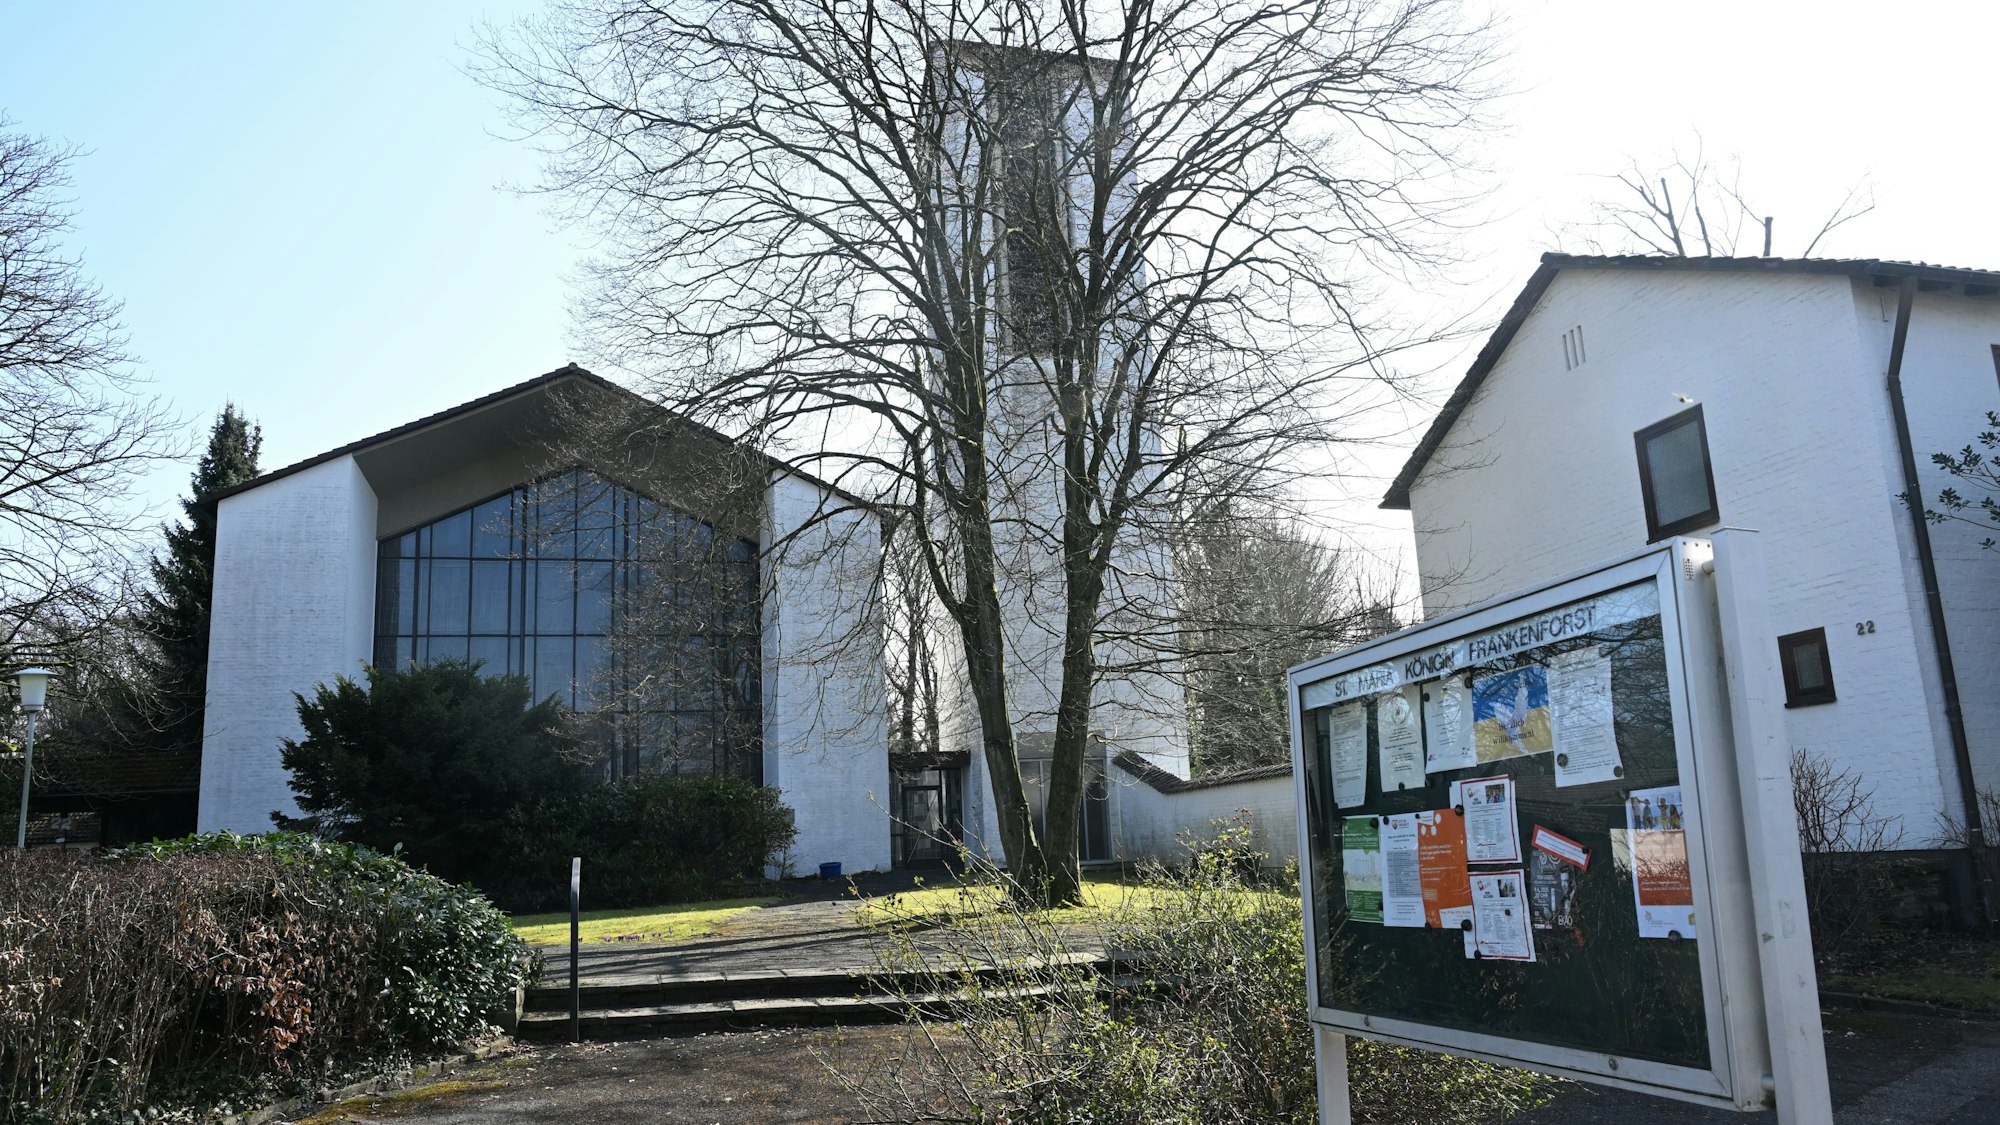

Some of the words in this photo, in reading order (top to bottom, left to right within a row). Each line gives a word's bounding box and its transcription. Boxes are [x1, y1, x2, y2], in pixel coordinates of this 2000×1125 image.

[1335, 680, 1348, 698] ST.
[1358, 671, 1394, 692] MARIA
[1405, 651, 1455, 680] KÖNIGIN
[1469, 605, 1596, 661] FRANKENFORST
[1855, 620, 1876, 636] 22
